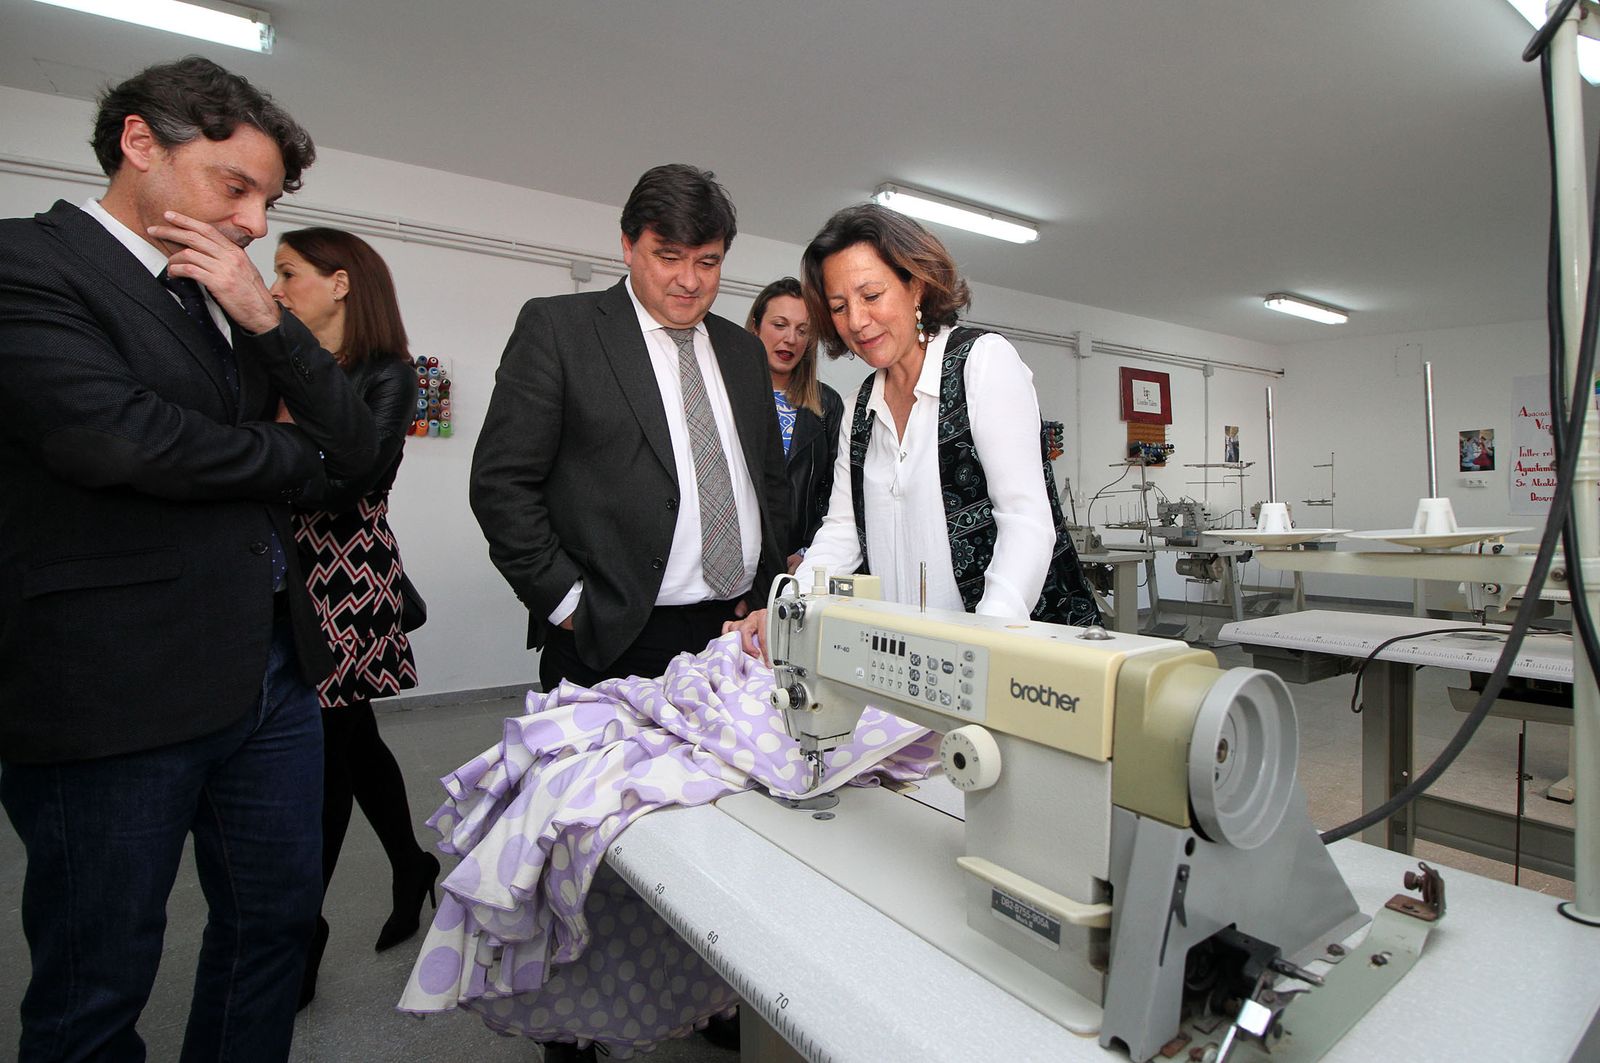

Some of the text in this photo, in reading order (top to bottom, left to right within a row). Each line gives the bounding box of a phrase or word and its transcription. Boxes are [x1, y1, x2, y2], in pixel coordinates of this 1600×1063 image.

[1518, 405, 1552, 417] Asociaci
[1513, 460, 1554, 477] Ayuntami
[1530, 492, 1556, 501] Desarr
[1010, 677, 1080, 713] brother
[614, 845, 623, 856] 40
[654, 882, 665, 895] 50
[707, 930, 719, 945] 60
[776, 992, 789, 1010] 70
